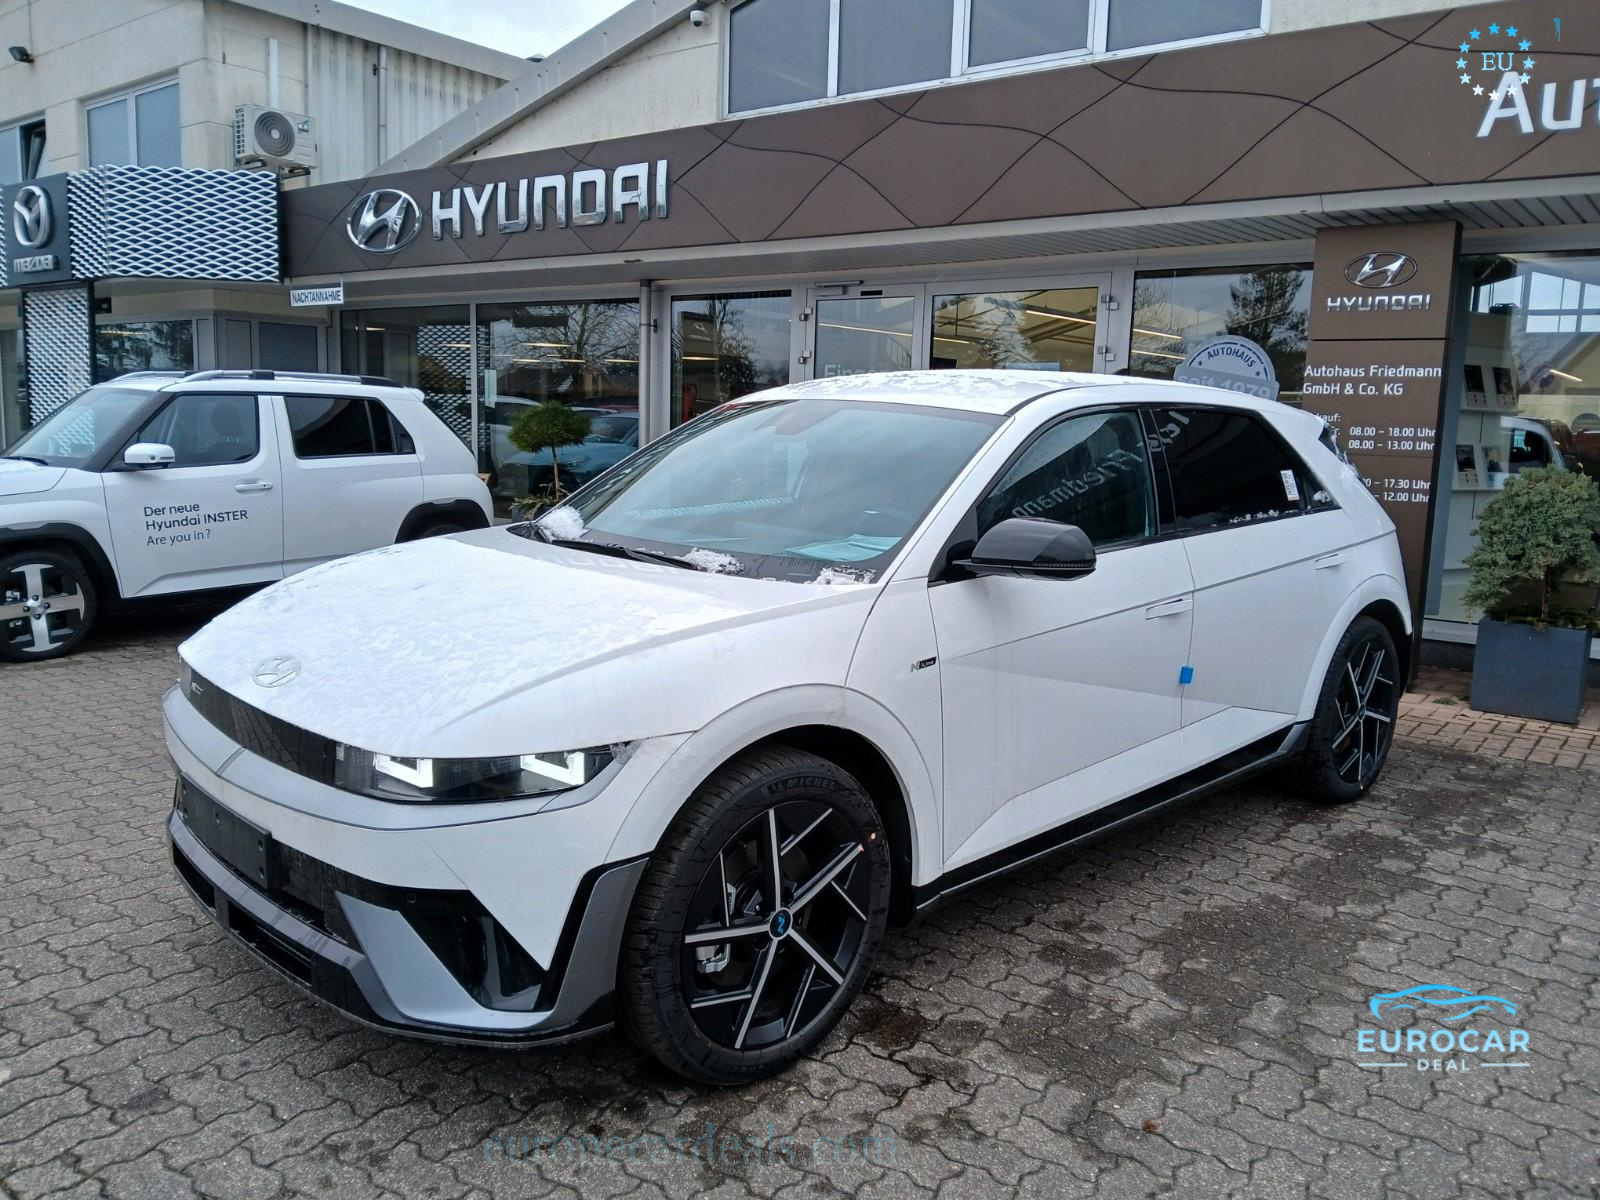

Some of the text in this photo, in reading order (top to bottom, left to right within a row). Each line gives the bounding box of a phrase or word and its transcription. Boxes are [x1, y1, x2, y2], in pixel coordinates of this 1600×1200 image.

[1476, 70, 1600, 138] Au
[431, 159, 668, 241] HYUNDAI
[292, 290, 341, 304] NACHTANNAHME
[1327, 294, 1431, 312] HYUNDAI
[1207, 346, 1256, 368] AUTOHAUS
[1304, 365, 1442, 377] Autohaus Friedmann
[1303, 382, 1404, 395] GmbH & Co. KG
[1349, 426, 1376, 436] 08.00
[1388, 427, 1414, 437] 18.00
[1417, 427, 1436, 437] Uhr
[1348, 439, 1375, 449] 08.00
[1387, 440, 1413, 450] 13.00
[1415, 441, 1435, 450] Uhr
[1384, 478, 1410, 489] 17.30
[1412, 479, 1431, 489] Uhr
[1383, 491, 1409, 502] 12.00
[1411, 492, 1430, 502] Uhr
[144, 503, 200, 517] Der neue
[145, 509, 249, 531] Hyundai INSTER
[146, 536, 167, 546] Are
[169, 533, 191, 546] you
